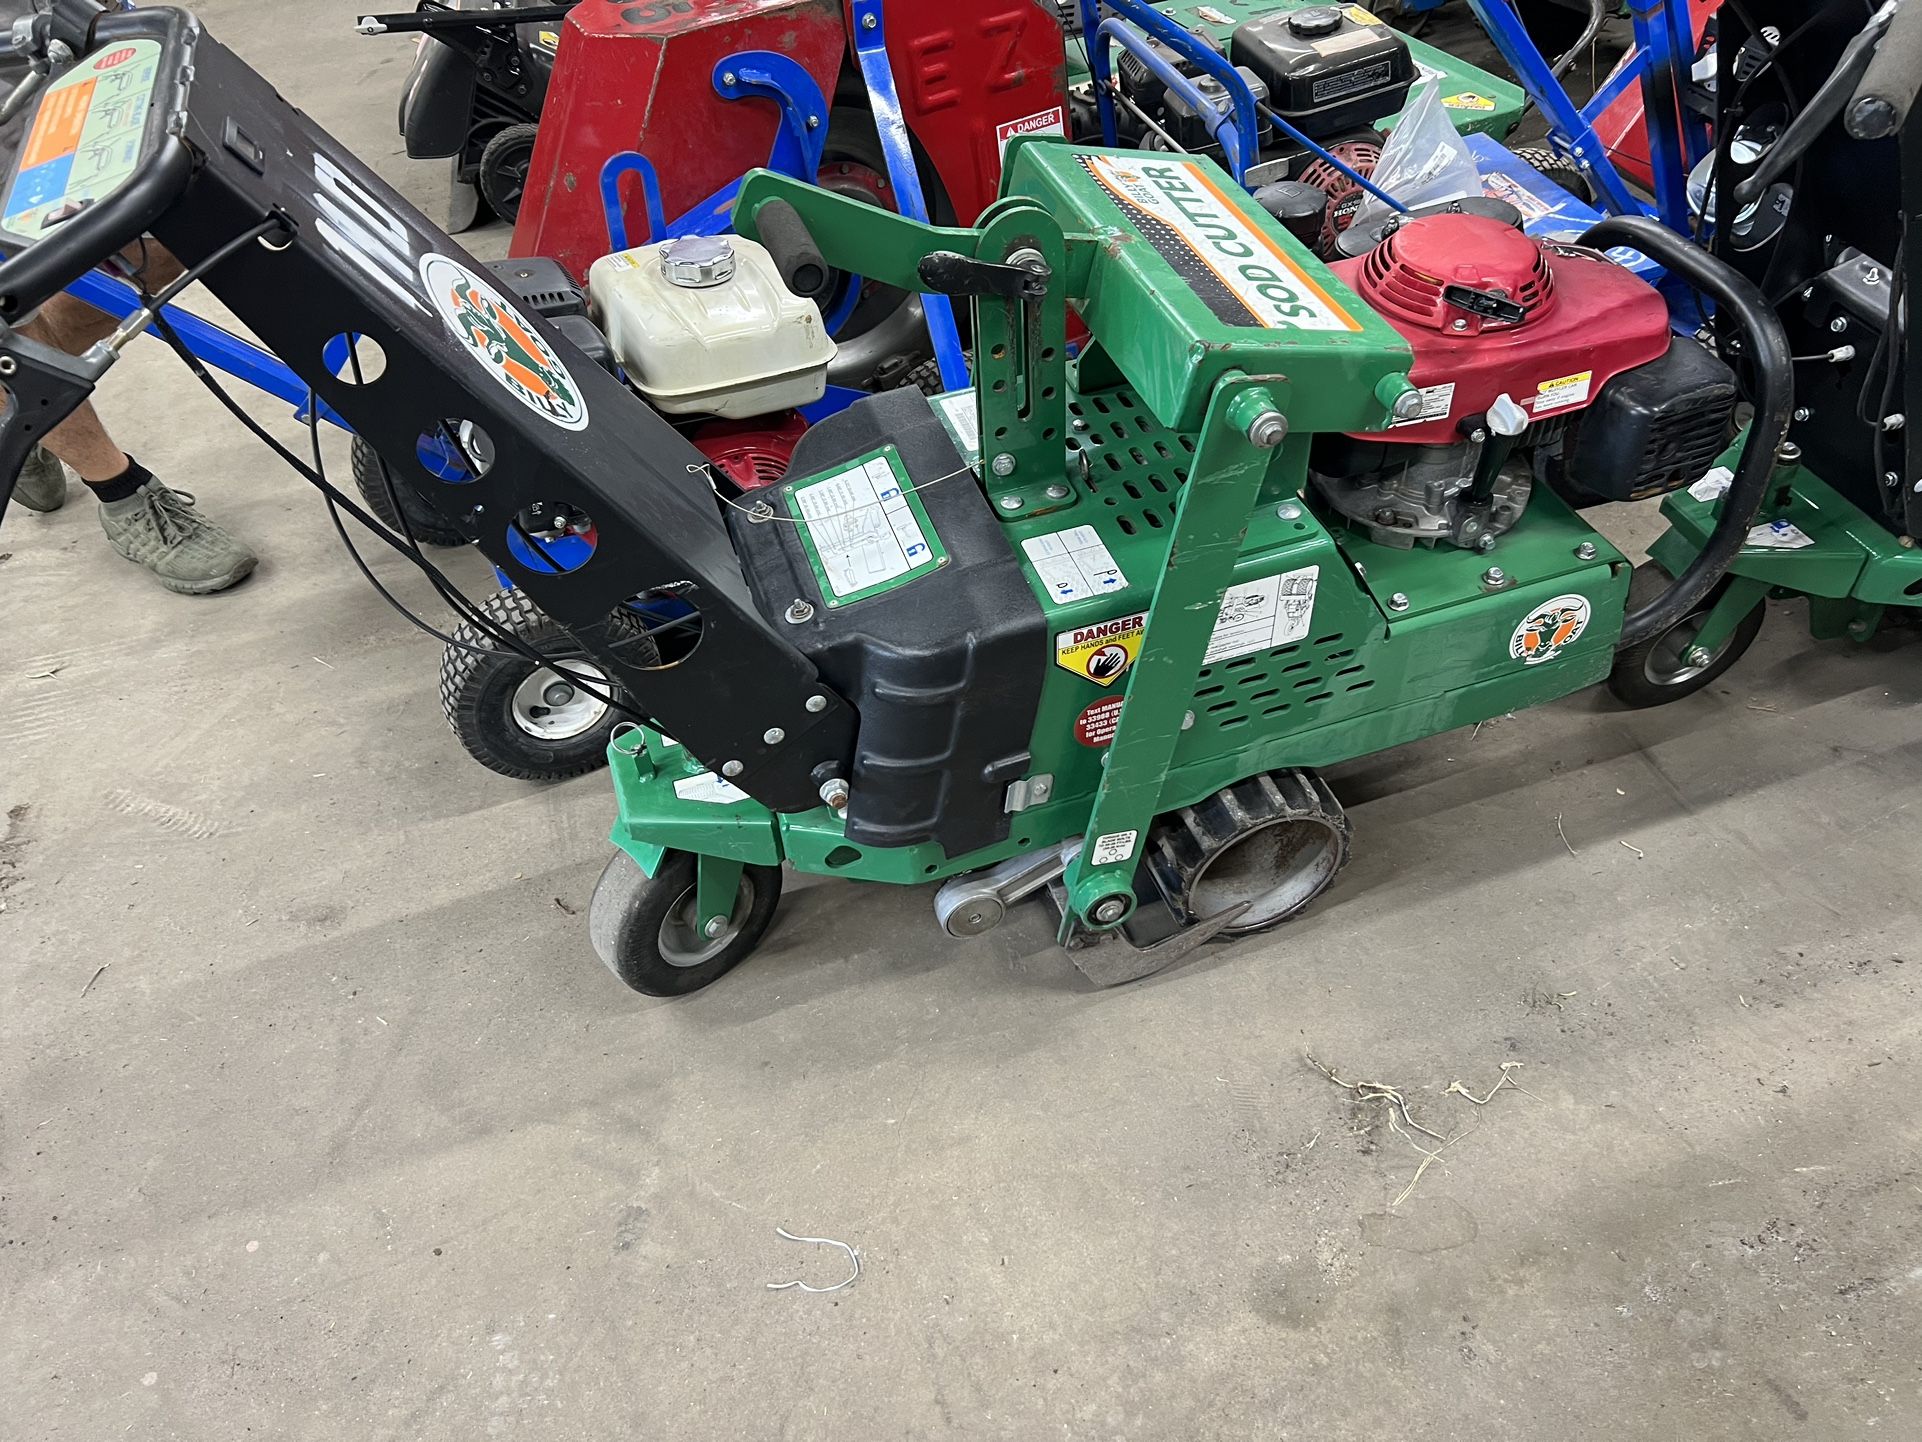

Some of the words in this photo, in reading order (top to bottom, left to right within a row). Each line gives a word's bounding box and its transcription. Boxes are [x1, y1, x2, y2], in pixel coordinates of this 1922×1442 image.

[1017, 113, 1055, 133] DANGER
[1140, 166, 1255, 258] CUTTER
[1333, 205, 1360, 218] HON
[1238, 263, 1317, 319] SOD
[1073, 615, 1144, 645] DANGER
[1061, 645, 1080, 656] KEEP
[1080, 639, 1104, 651] HANDS
[1105, 635, 1117, 645] and
[1118, 630, 1135, 641] FEET
[1086, 707, 1101, 717] Text
[1079, 718, 1087, 726] to
[1085, 720, 1108, 731] 33433
[1085, 730, 1096, 738] for
